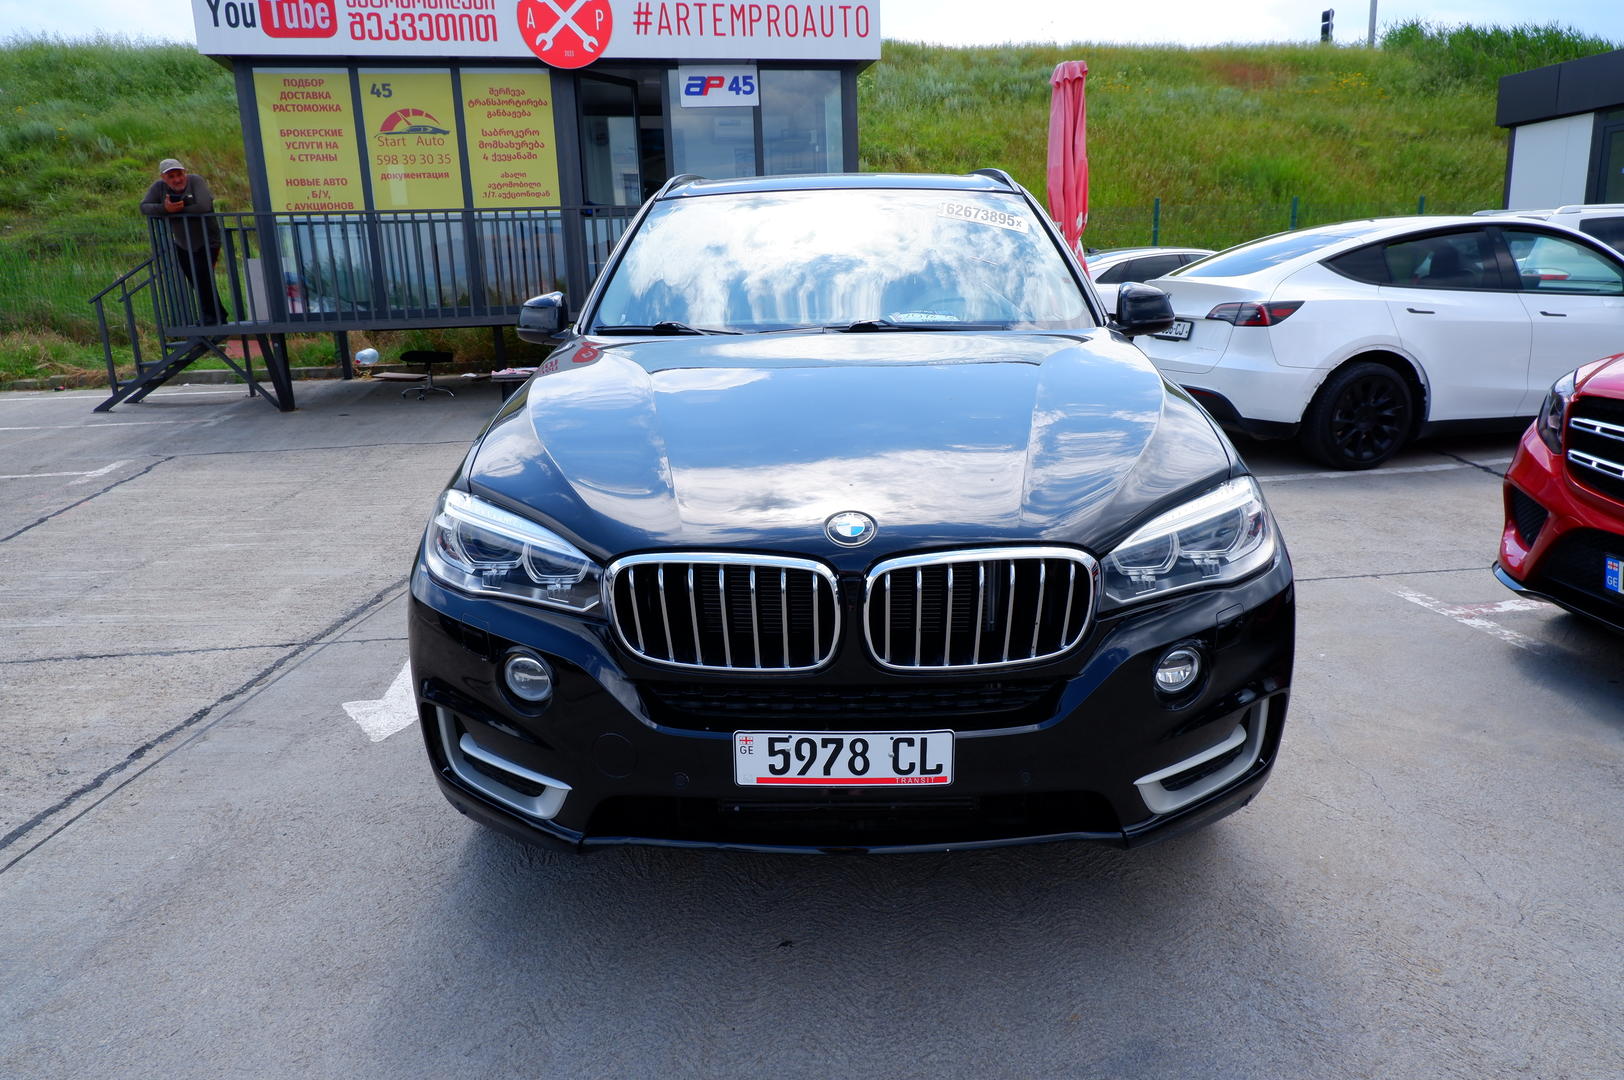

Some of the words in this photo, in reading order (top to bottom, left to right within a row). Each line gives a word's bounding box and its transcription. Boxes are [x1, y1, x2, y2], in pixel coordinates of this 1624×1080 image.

[526, 7, 536, 29] A
[595, 9, 604, 31] P
[633, 2, 870, 38] #ARTEMPROAUTO
[348, 12, 498, 42] შეკვეთით
[283, 78, 325, 88] ПОДБОР
[728, 76, 755, 96] 45
[280, 91, 332, 101] ДОСТАВКА
[370, 83, 393, 98] 45
[272, 103, 342, 113] РАСТОМОЖКА
[280, 128, 344, 138] БРОКЕРСКИЕ
[285, 141, 323, 150] УСЛУГИ
[325, 141, 339, 150] НА
[378, 136, 407, 147] Start
[416, 135, 445, 147] Auto
[289, 154, 296, 162] 4
[298, 153, 338, 162] СТРАНЫ
[376, 154, 399, 166] 598
[401, 154, 416, 165] 39
[419, 153, 434, 165] 30
[437, 153, 452, 165] 35
[286, 178, 321, 187] НОВЫЕ
[323, 177, 348, 187] АВТО
[380, 171, 450, 182] документация
[294, 202, 355, 212] АУКЦИОНОВ
[1607, 575, 1618, 588] GE
[739, 745, 754, 755] GE
[767, 736, 871, 776] 5978
[891, 737, 944, 776] CL
[896, 776, 935, 784] TRANSIT
